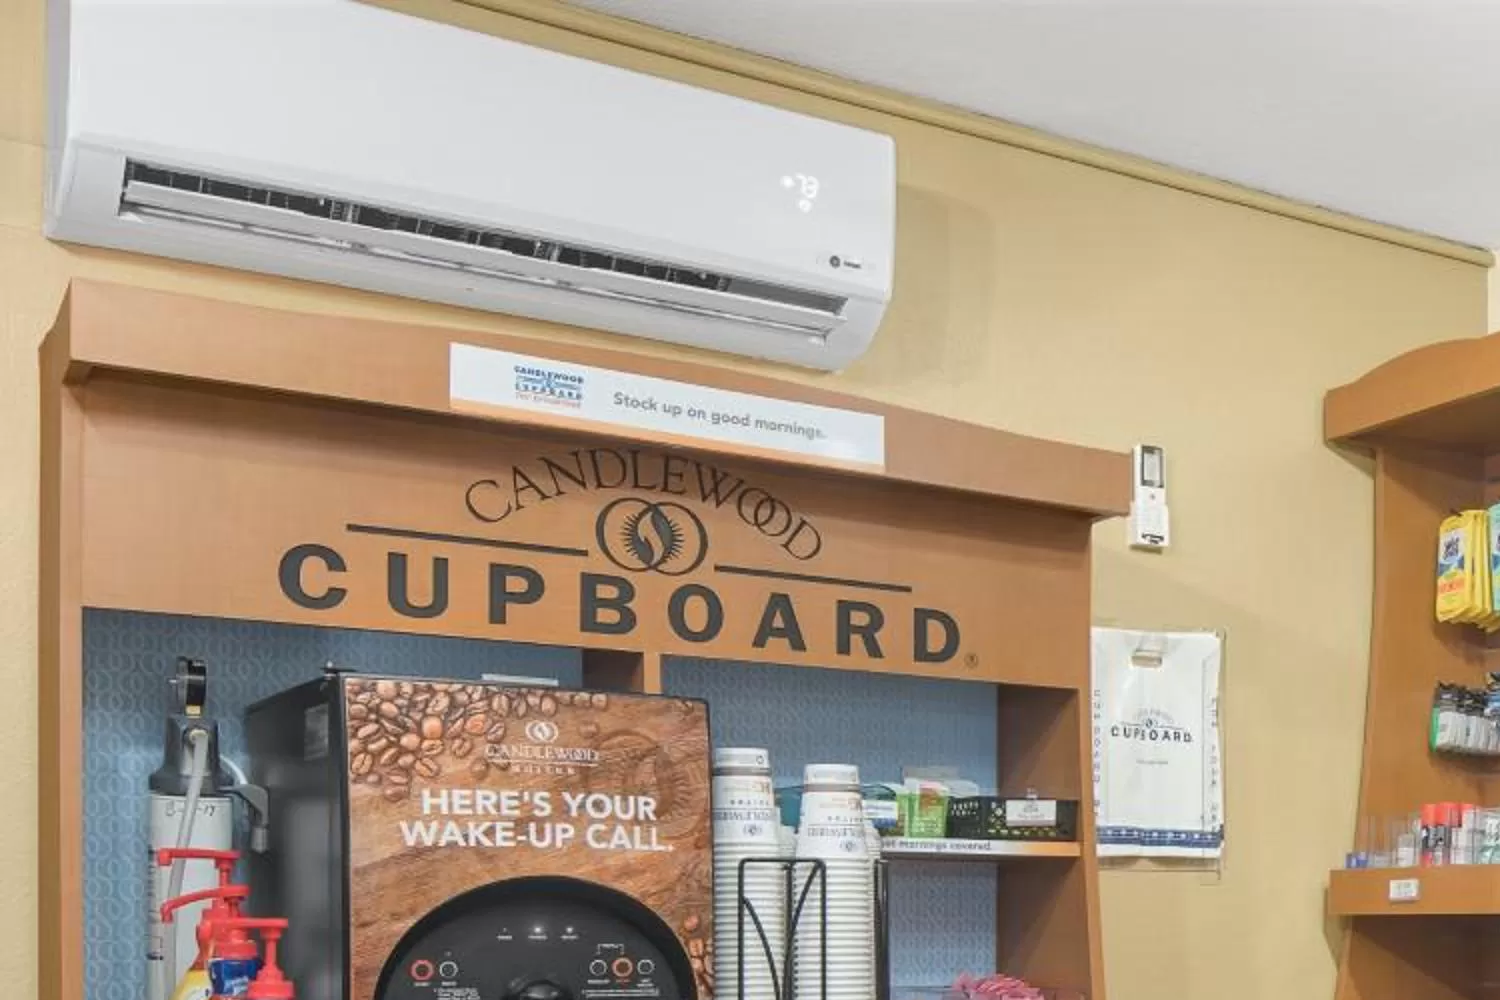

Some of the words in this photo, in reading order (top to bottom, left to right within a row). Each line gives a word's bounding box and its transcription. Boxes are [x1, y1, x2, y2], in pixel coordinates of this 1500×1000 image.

[613, 391, 657, 412] Stock
[663, 400, 682, 417] up
[688, 406, 706, 419] on
[711, 410, 751, 427] good
[754, 417, 826, 441] mornings.
[465, 446, 821, 562] CANDLEWOOD
[277, 544, 961, 664] CUPBOARD
[420, 788, 551, 818] HERE'S
[561, 791, 658, 821] YOUR
[399, 819, 576, 849] WAKE-UP
[586, 823, 674, 852] CALL.
